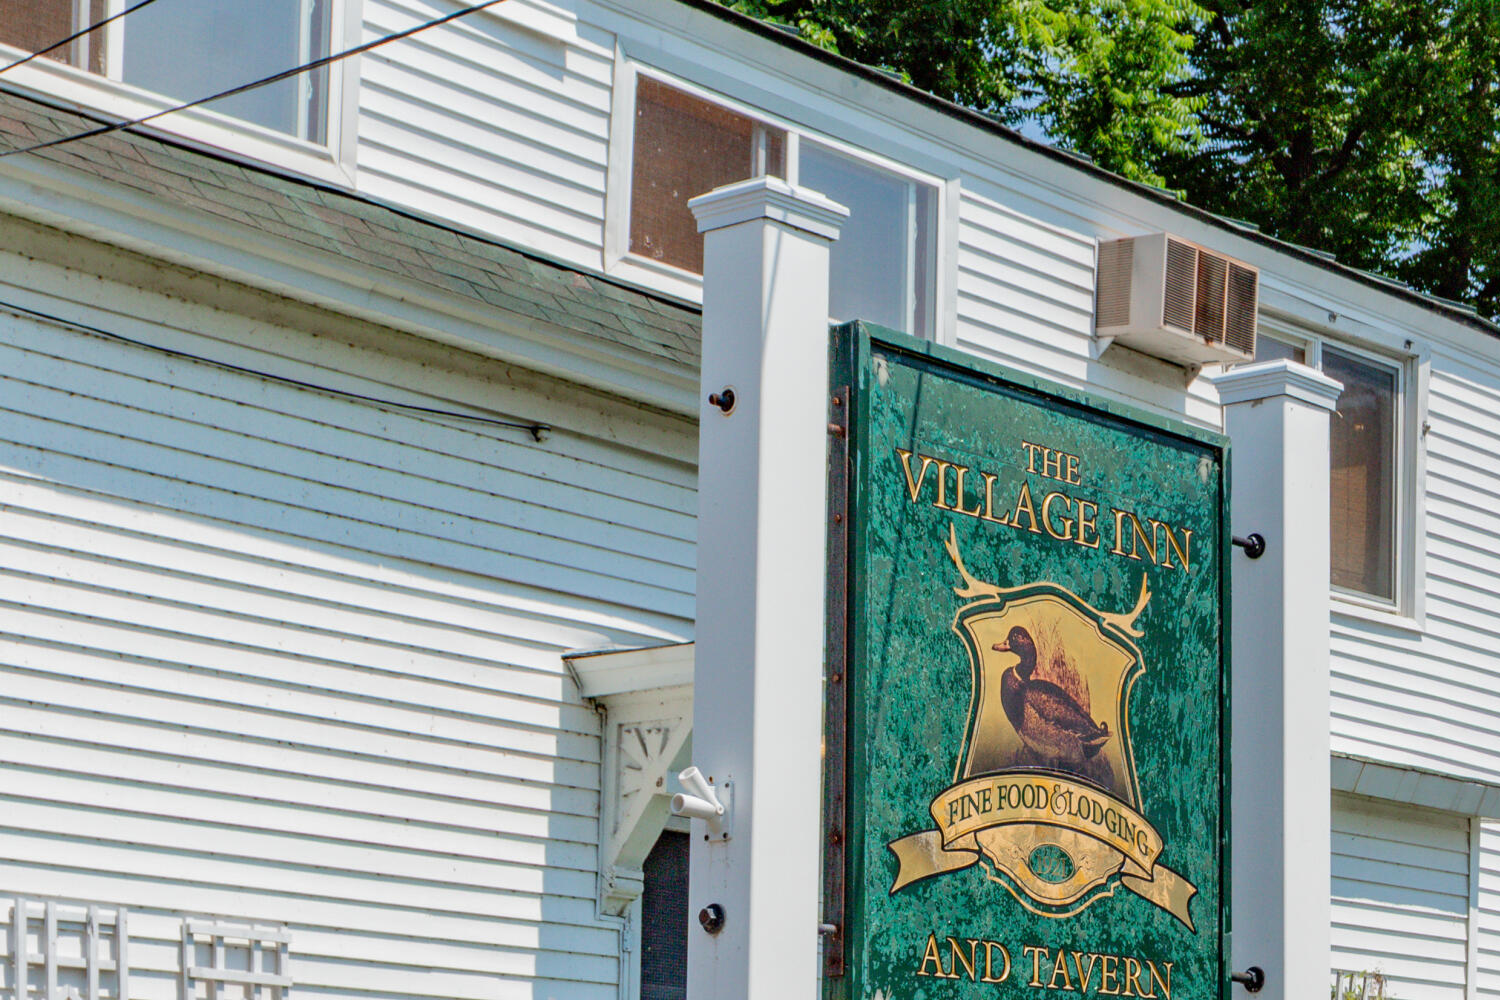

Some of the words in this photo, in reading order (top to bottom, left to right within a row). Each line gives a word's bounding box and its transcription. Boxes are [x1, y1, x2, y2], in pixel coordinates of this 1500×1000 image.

[1022, 440, 1082, 486] THE
[895, 448, 1100, 549] VILLAGE
[1111, 508, 1194, 573] INN
[948, 788, 993, 828] FINE
[997, 784, 1049, 810] FOOD
[1066, 790, 1150, 857] LODGING
[917, 932, 1011, 983] AND
[1023, 944, 1174, 1000] TAVERN
